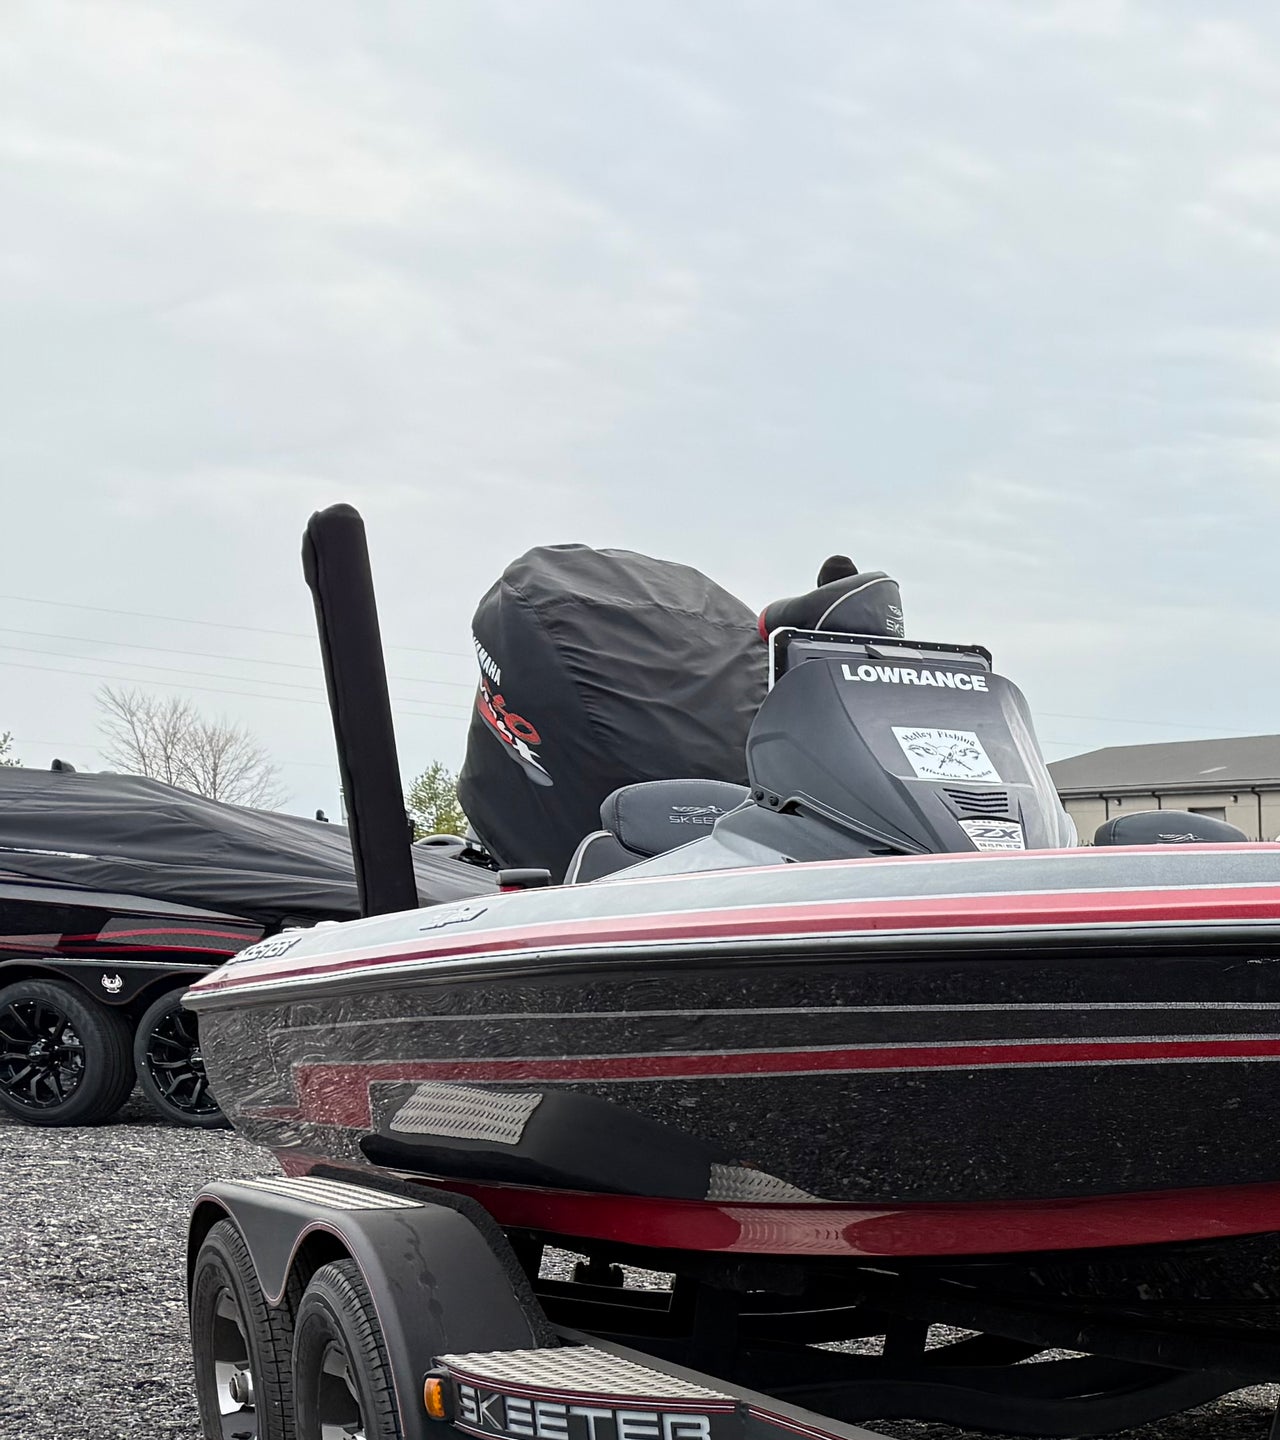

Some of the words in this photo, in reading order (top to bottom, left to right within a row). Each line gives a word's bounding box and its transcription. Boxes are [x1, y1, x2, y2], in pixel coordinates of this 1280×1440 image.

[841, 664, 990, 692] LOWRANCE
[669, 815, 719, 825] SKEE
[971, 828, 1019, 840] ZX
